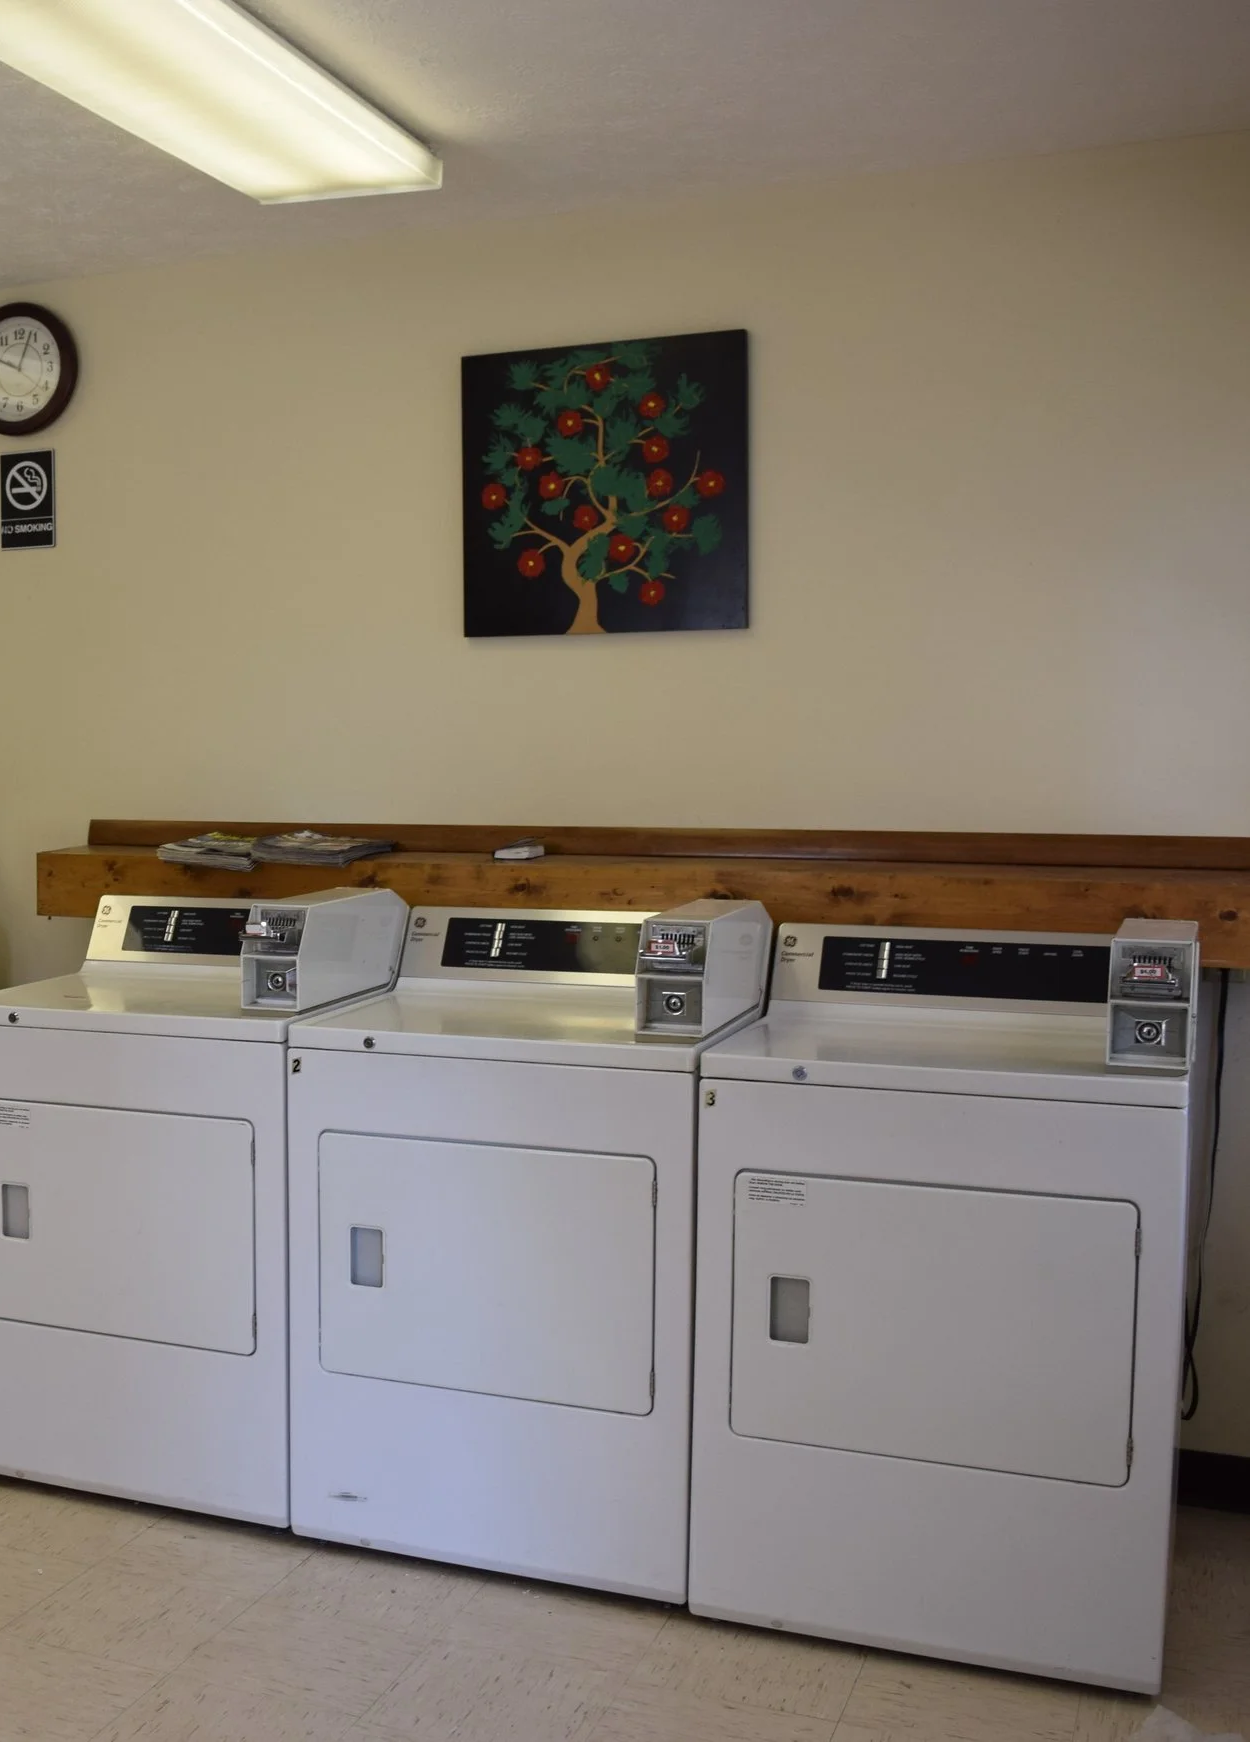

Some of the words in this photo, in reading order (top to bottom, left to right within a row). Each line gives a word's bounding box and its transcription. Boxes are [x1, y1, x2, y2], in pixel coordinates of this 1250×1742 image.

[14, 328, 25, 340] 12
[33, 331, 38, 343] 1
[0, 335, 9, 347] 11
[43, 343, 50, 355] 2
[47, 361, 54, 372] 3
[42, 380, 49, 391] 4
[2, 397, 9, 408] 7
[32, 394, 39, 405] 5
[16, 401, 23, 412] 6
[15, 522, 53, 533] SMOKING
[293, 1059, 300, 1072] 2
[706, 1091, 715, 1106] 3
